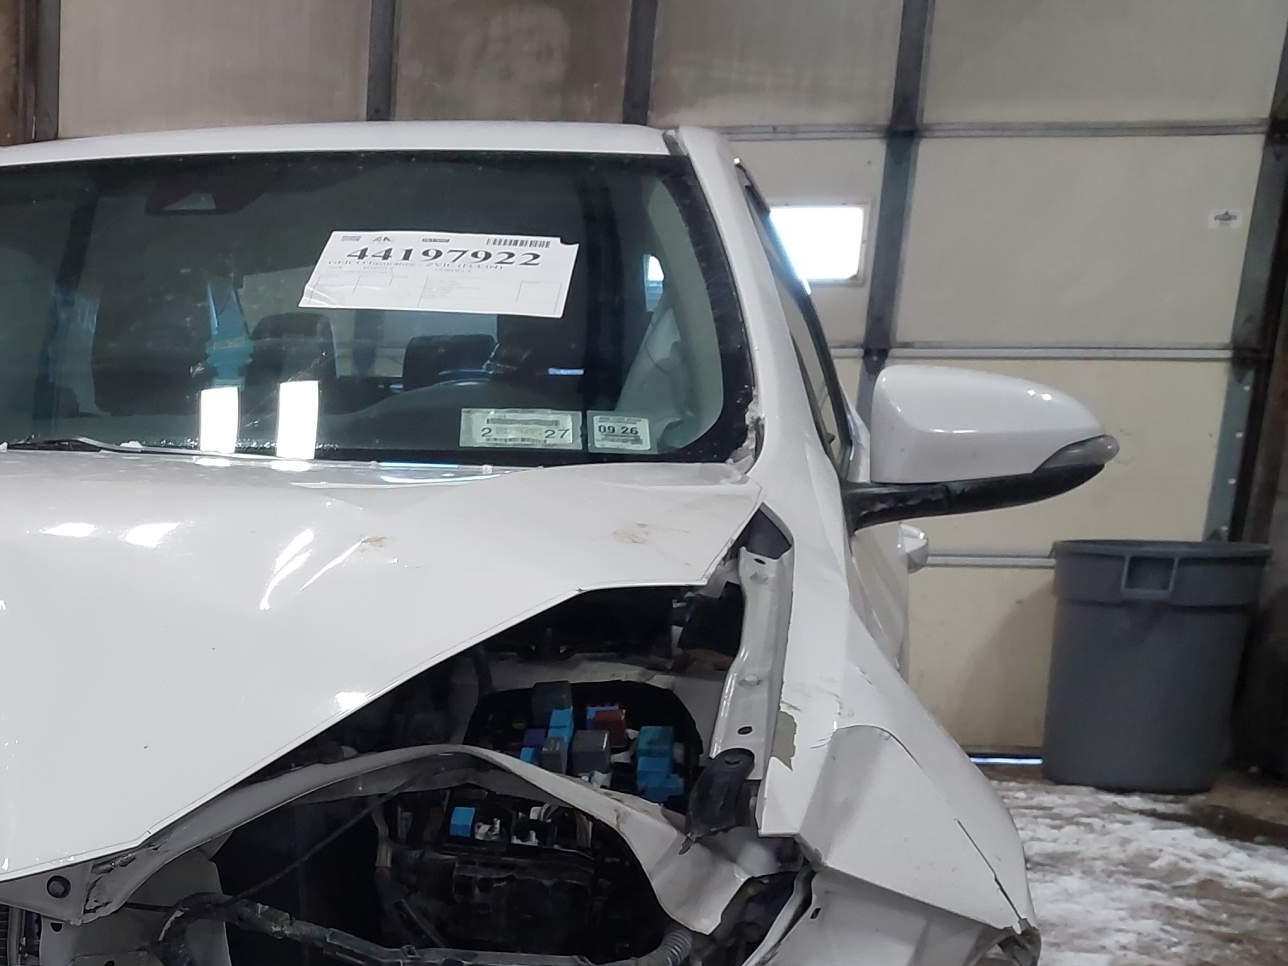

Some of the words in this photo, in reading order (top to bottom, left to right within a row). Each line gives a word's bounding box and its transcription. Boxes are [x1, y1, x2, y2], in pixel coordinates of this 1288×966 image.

[347, 247, 540, 265] 44197922
[544, 429, 570, 439] 27
[598, 424, 616, 433] 09
[621, 425, 639, 435] 26
